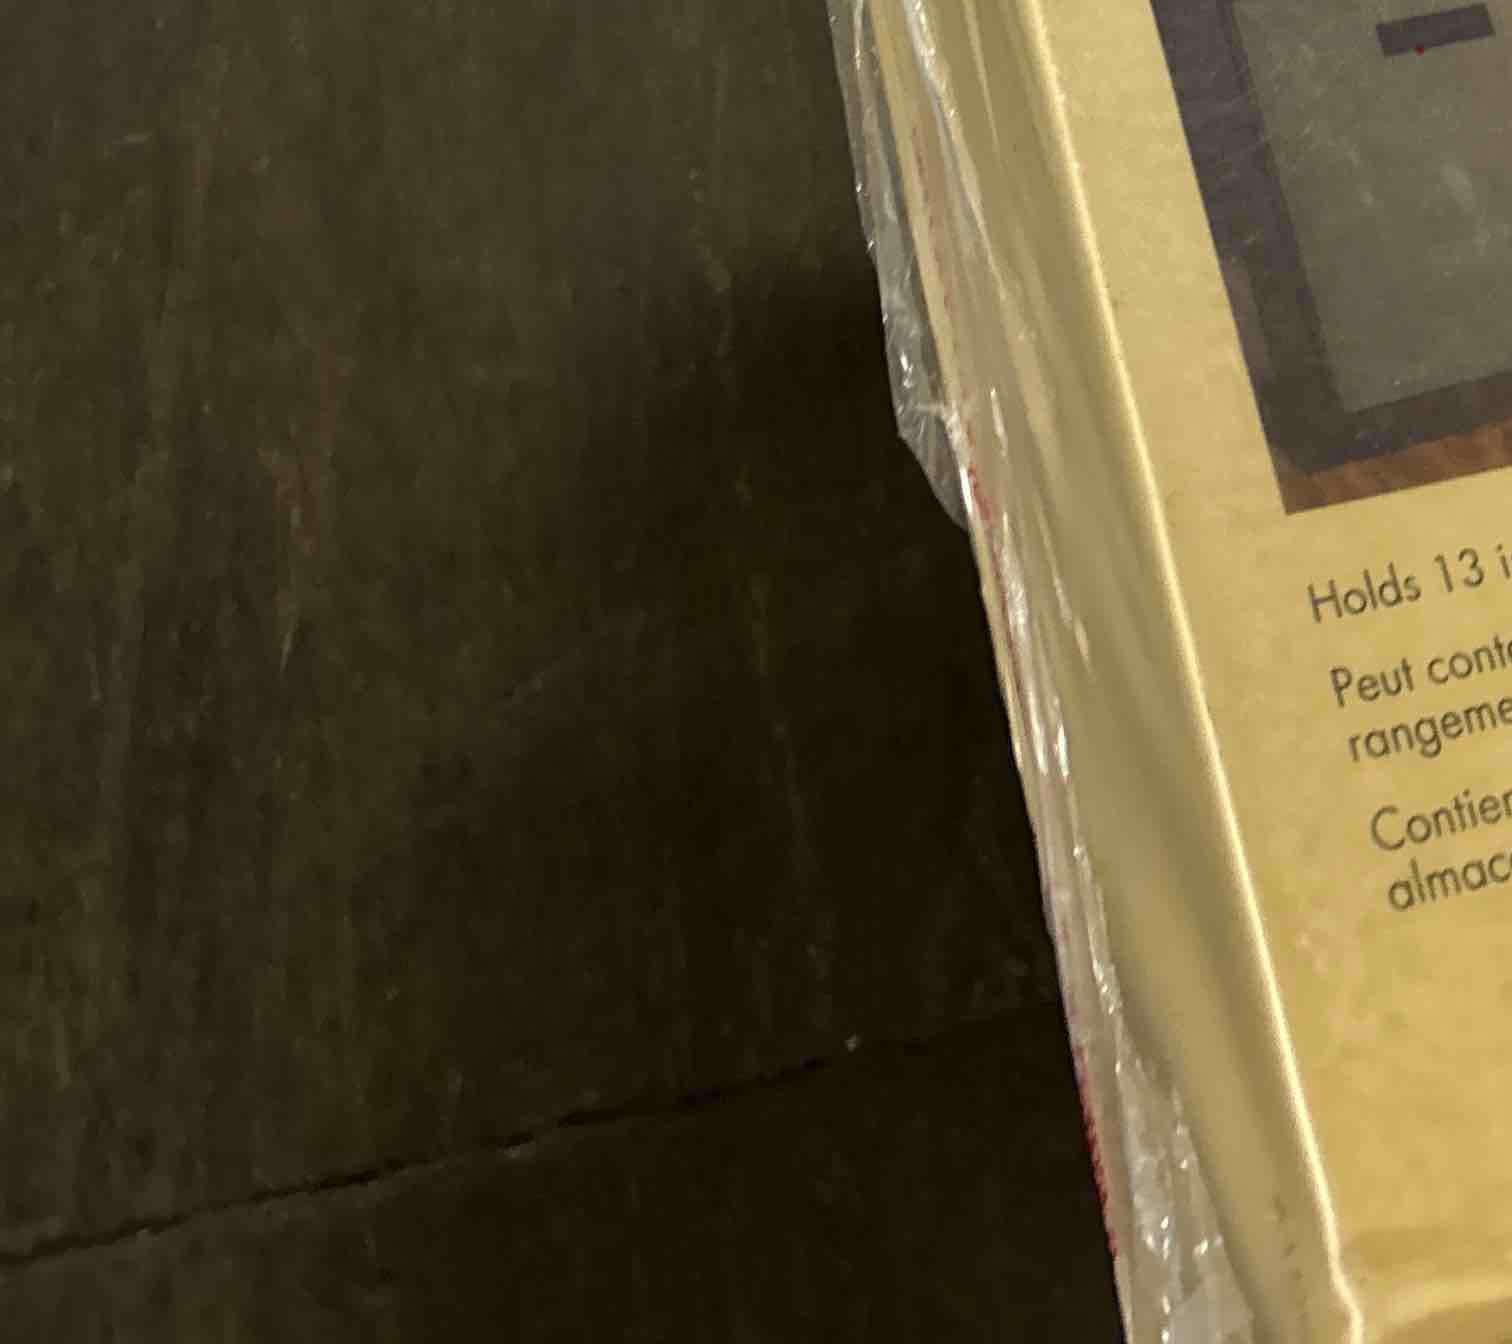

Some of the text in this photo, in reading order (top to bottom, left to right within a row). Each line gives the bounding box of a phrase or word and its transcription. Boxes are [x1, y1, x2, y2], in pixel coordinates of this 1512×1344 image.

[1308, 572, 1422, 624] Holds
[1434, 549, 1486, 593] 13
[1331, 665, 1414, 709] Peut
